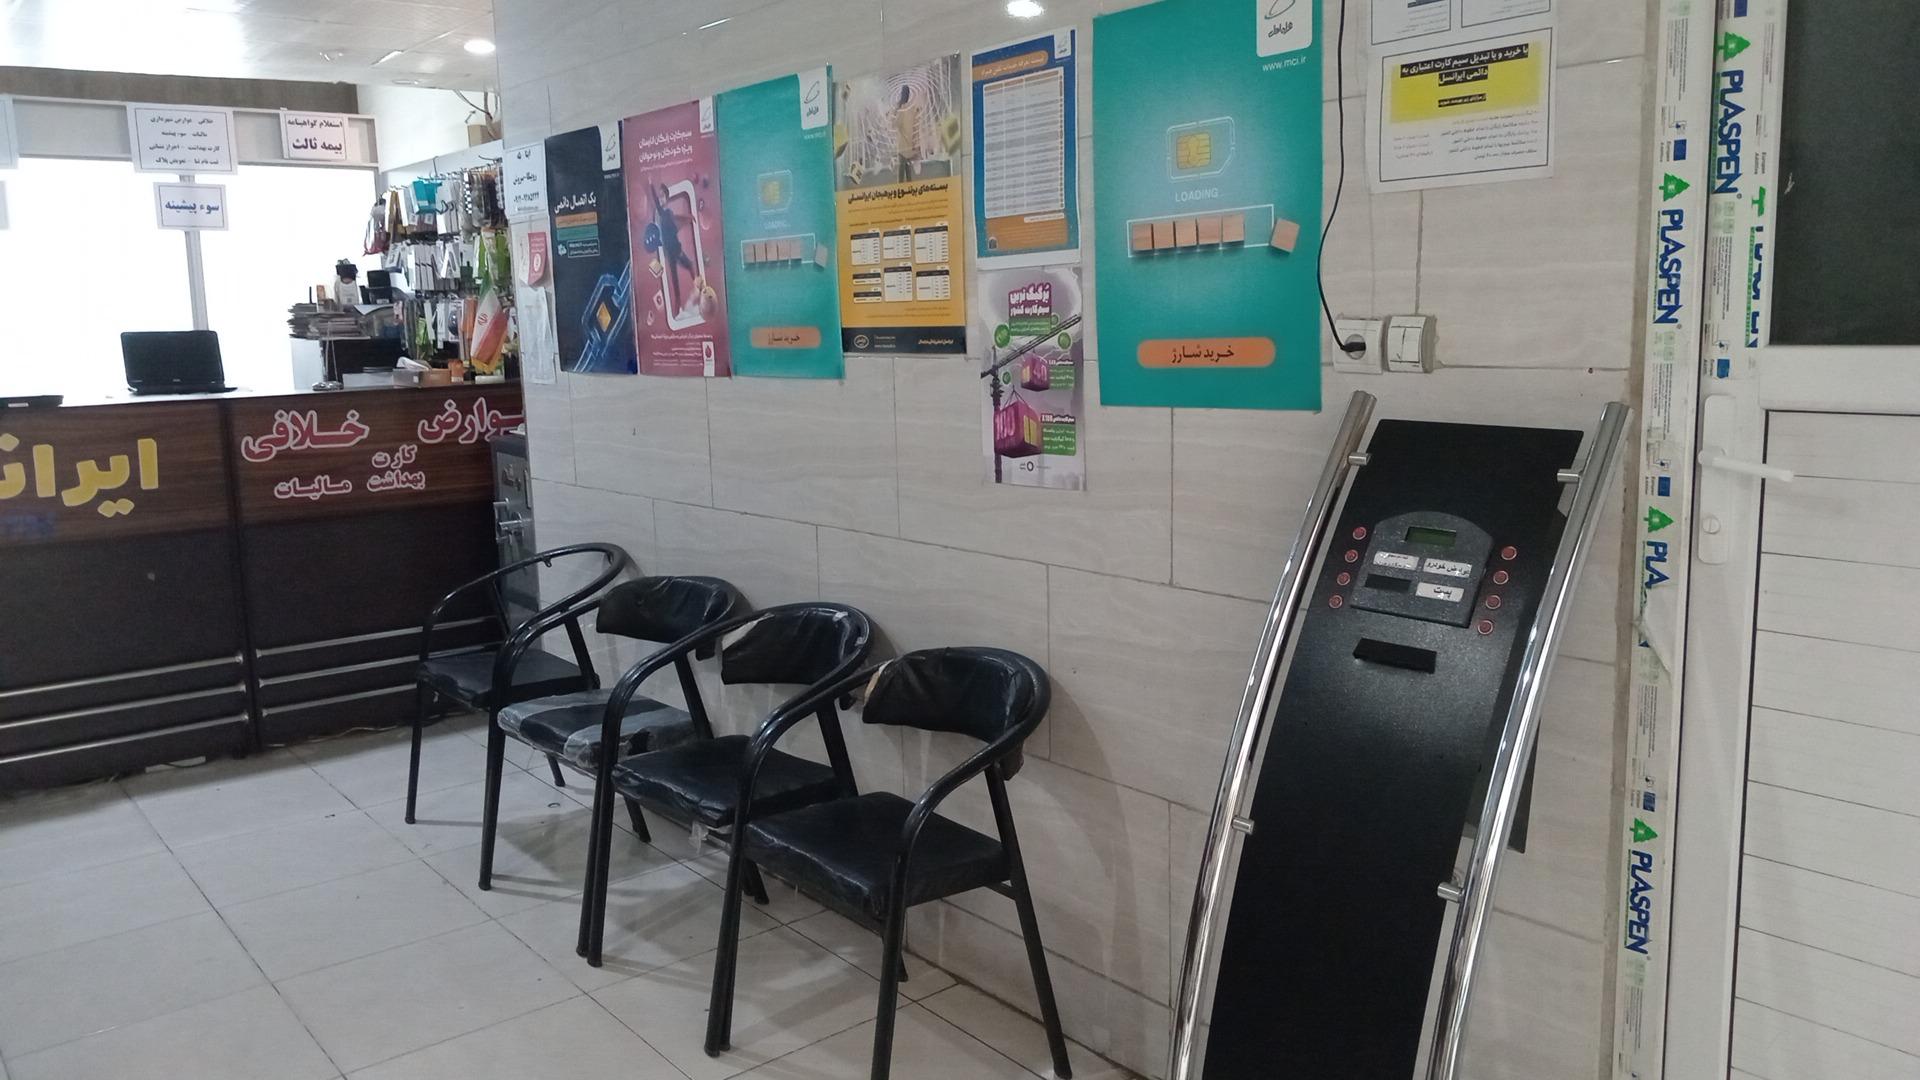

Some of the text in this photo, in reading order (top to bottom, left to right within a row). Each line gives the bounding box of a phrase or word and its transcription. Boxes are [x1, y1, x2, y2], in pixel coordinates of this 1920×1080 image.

[1470, 53, 1490, 65] تبدیل
[1503, 49, 1521, 58] خرید
[1402, 66, 1409, 74] به
[1410, 61, 1434, 73] اعتباری
[1434, 58, 1451, 69] کارت
[1452, 57, 1469, 68] سیم
[1439, 68, 1489, 84] دائمی ایرانسل
[319, 119, 342, 128] استعلام
[1712, 69, 1746, 195] PLASPEN
[293, 137, 342, 154] بیمه ثالث
[1174, 188, 1219, 202] LOADING
[165, 200, 219, 214] سوء پیشینه
[1653, 208, 1686, 324] PLASPEN
[1171, 345, 1235, 364] خرید شارژ
[418, 397, 526, 444] وارض
[241, 410, 370, 463] خلافی
[371, 444, 418, 468] کارت
[273, 475, 352, 500] مالیات
[366, 468, 426, 491] بهداشت
[1625, 850, 1655, 955] PLASPEN
